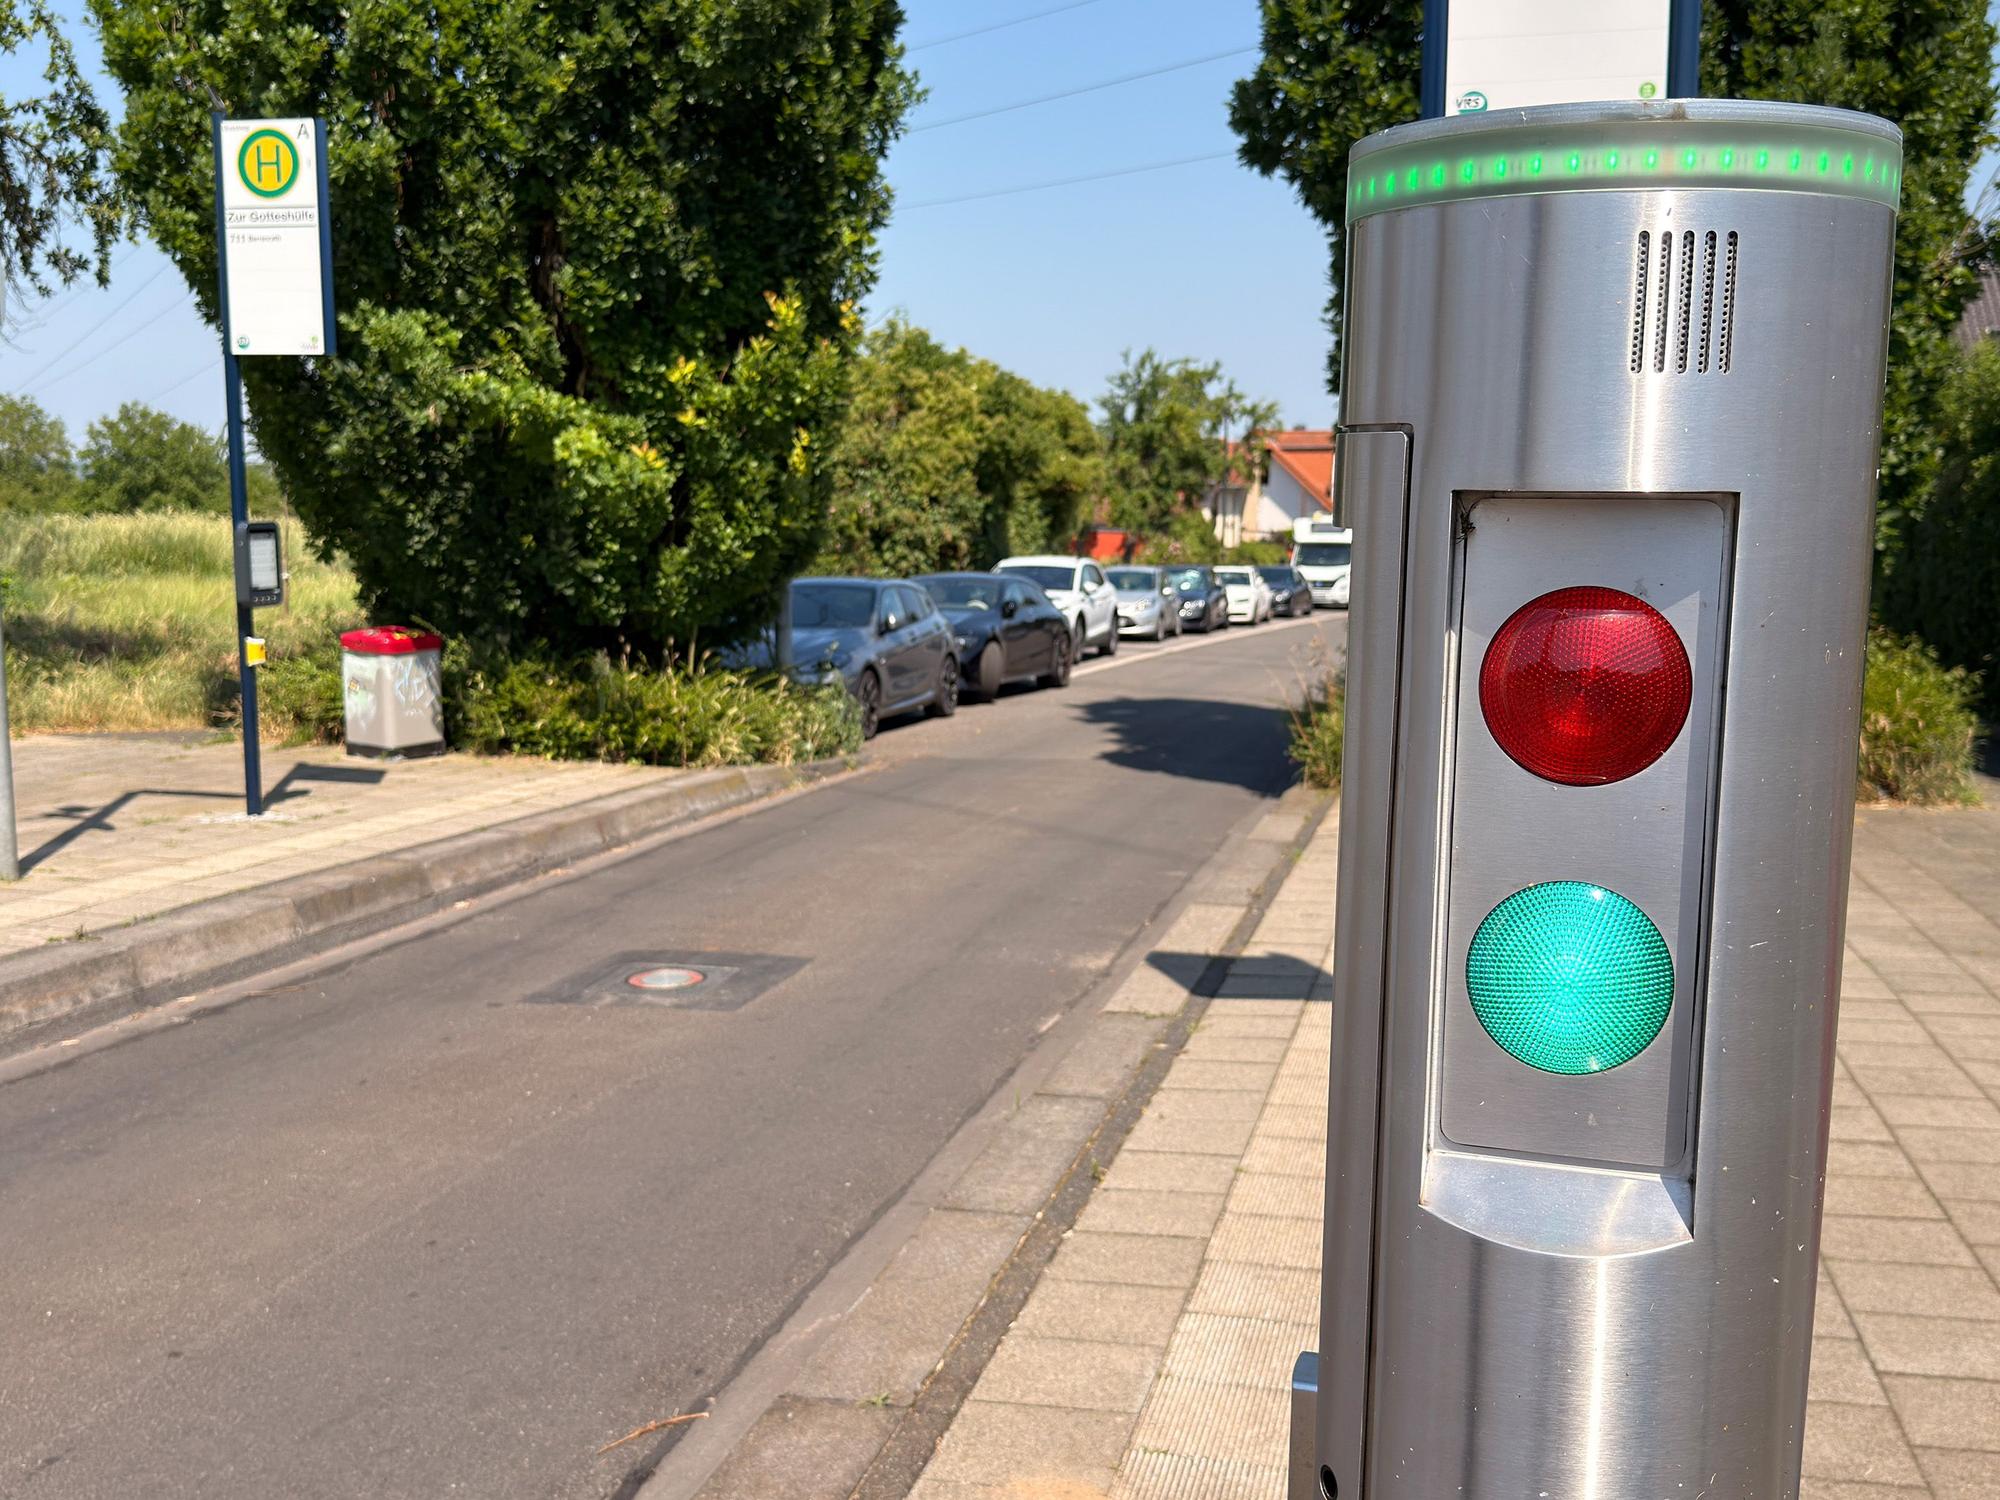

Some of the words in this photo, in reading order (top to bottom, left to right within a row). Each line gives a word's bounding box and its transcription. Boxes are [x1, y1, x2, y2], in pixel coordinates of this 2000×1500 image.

[297, 123, 309, 139] A
[256, 145, 281, 183] H
[228, 212, 246, 223] Zur
